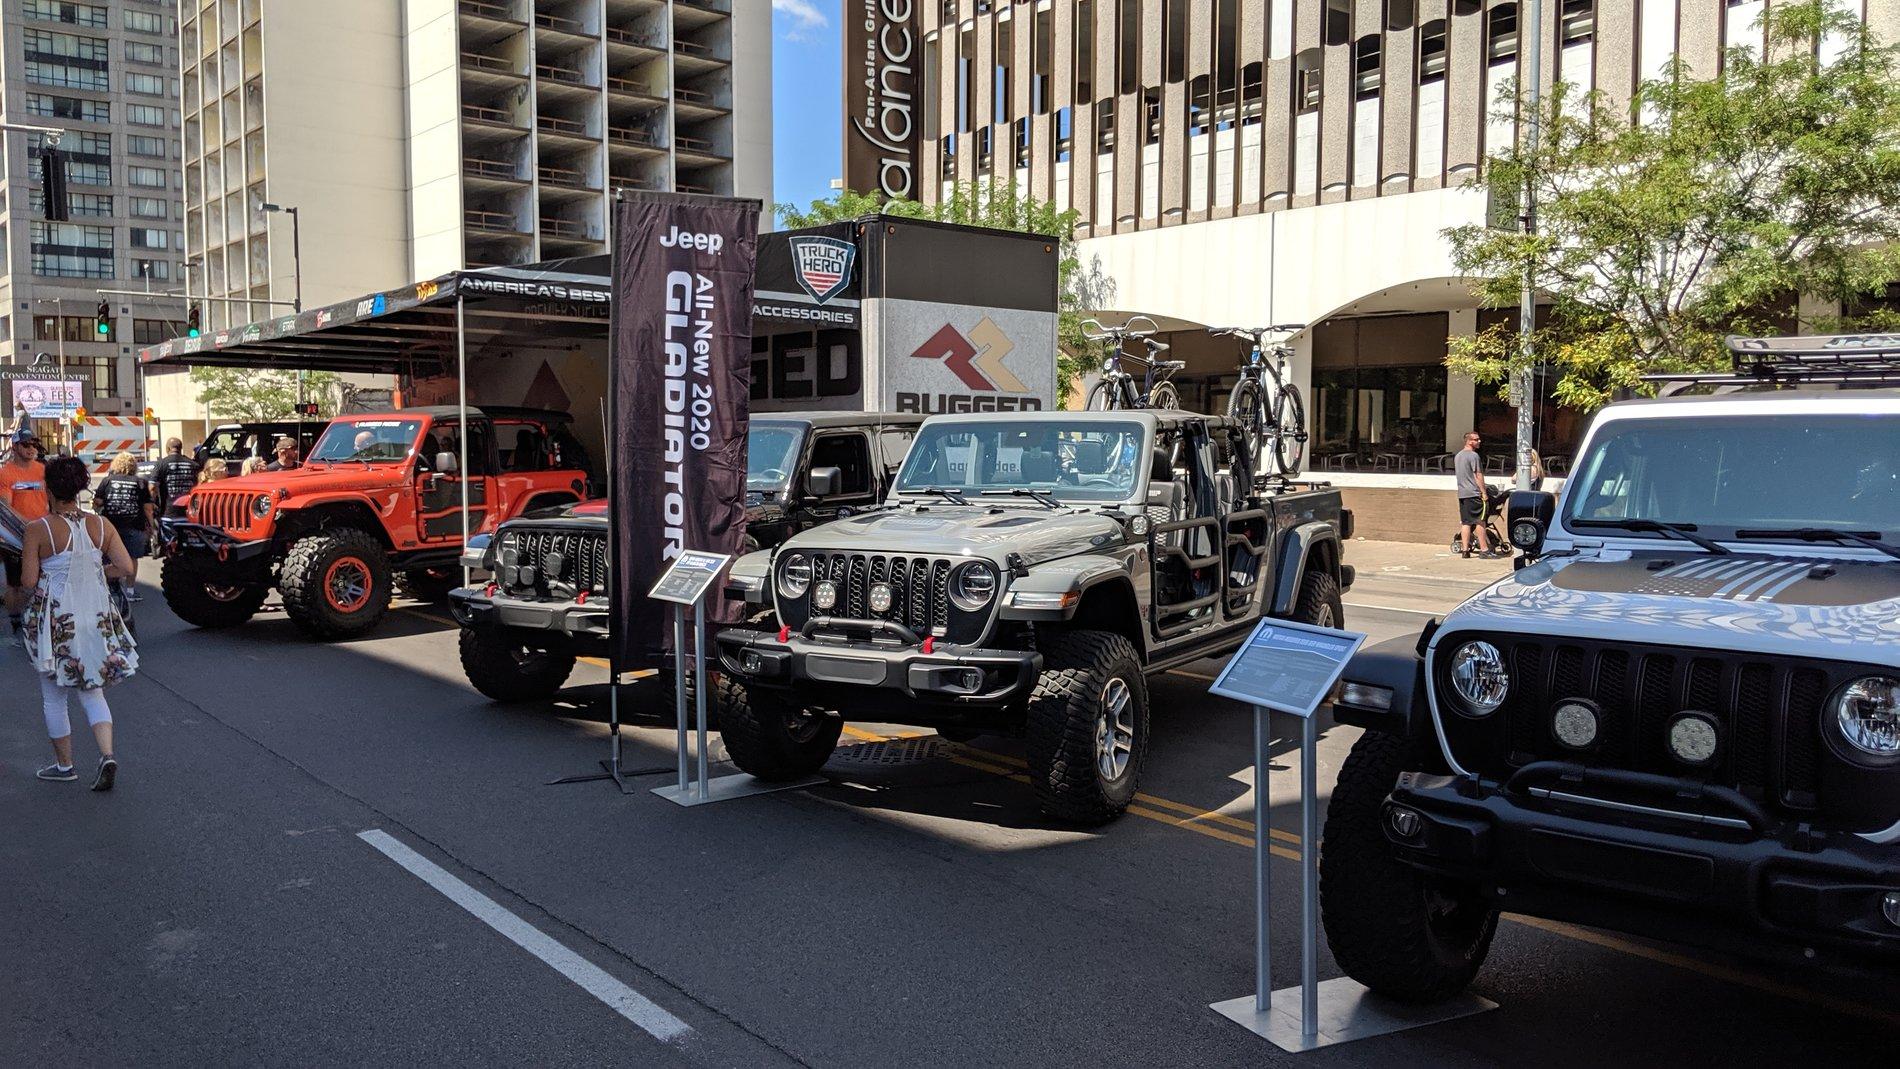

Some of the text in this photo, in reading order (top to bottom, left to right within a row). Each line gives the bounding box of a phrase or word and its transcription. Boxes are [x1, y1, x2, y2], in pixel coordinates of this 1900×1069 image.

[864, 39, 876, 128] Pan-Asian
[853, 0, 912, 214] alance
[659, 225, 724, 256] Jeep
[799, 245, 846, 262] TRUCK
[803, 258, 842, 273] HERO
[458, 277, 567, 299] AMERICA'S
[569, 288, 612, 302] BEST
[752, 304, 854, 324] ACCESSORIES
[26, 365, 64, 374] SEAGAT
[690, 273, 714, 450] All-New 2020
[51, 390, 75, 401] FES
[896, 392, 1042, 415] RUGGED
[662, 270, 692, 562] GLADIATOR
